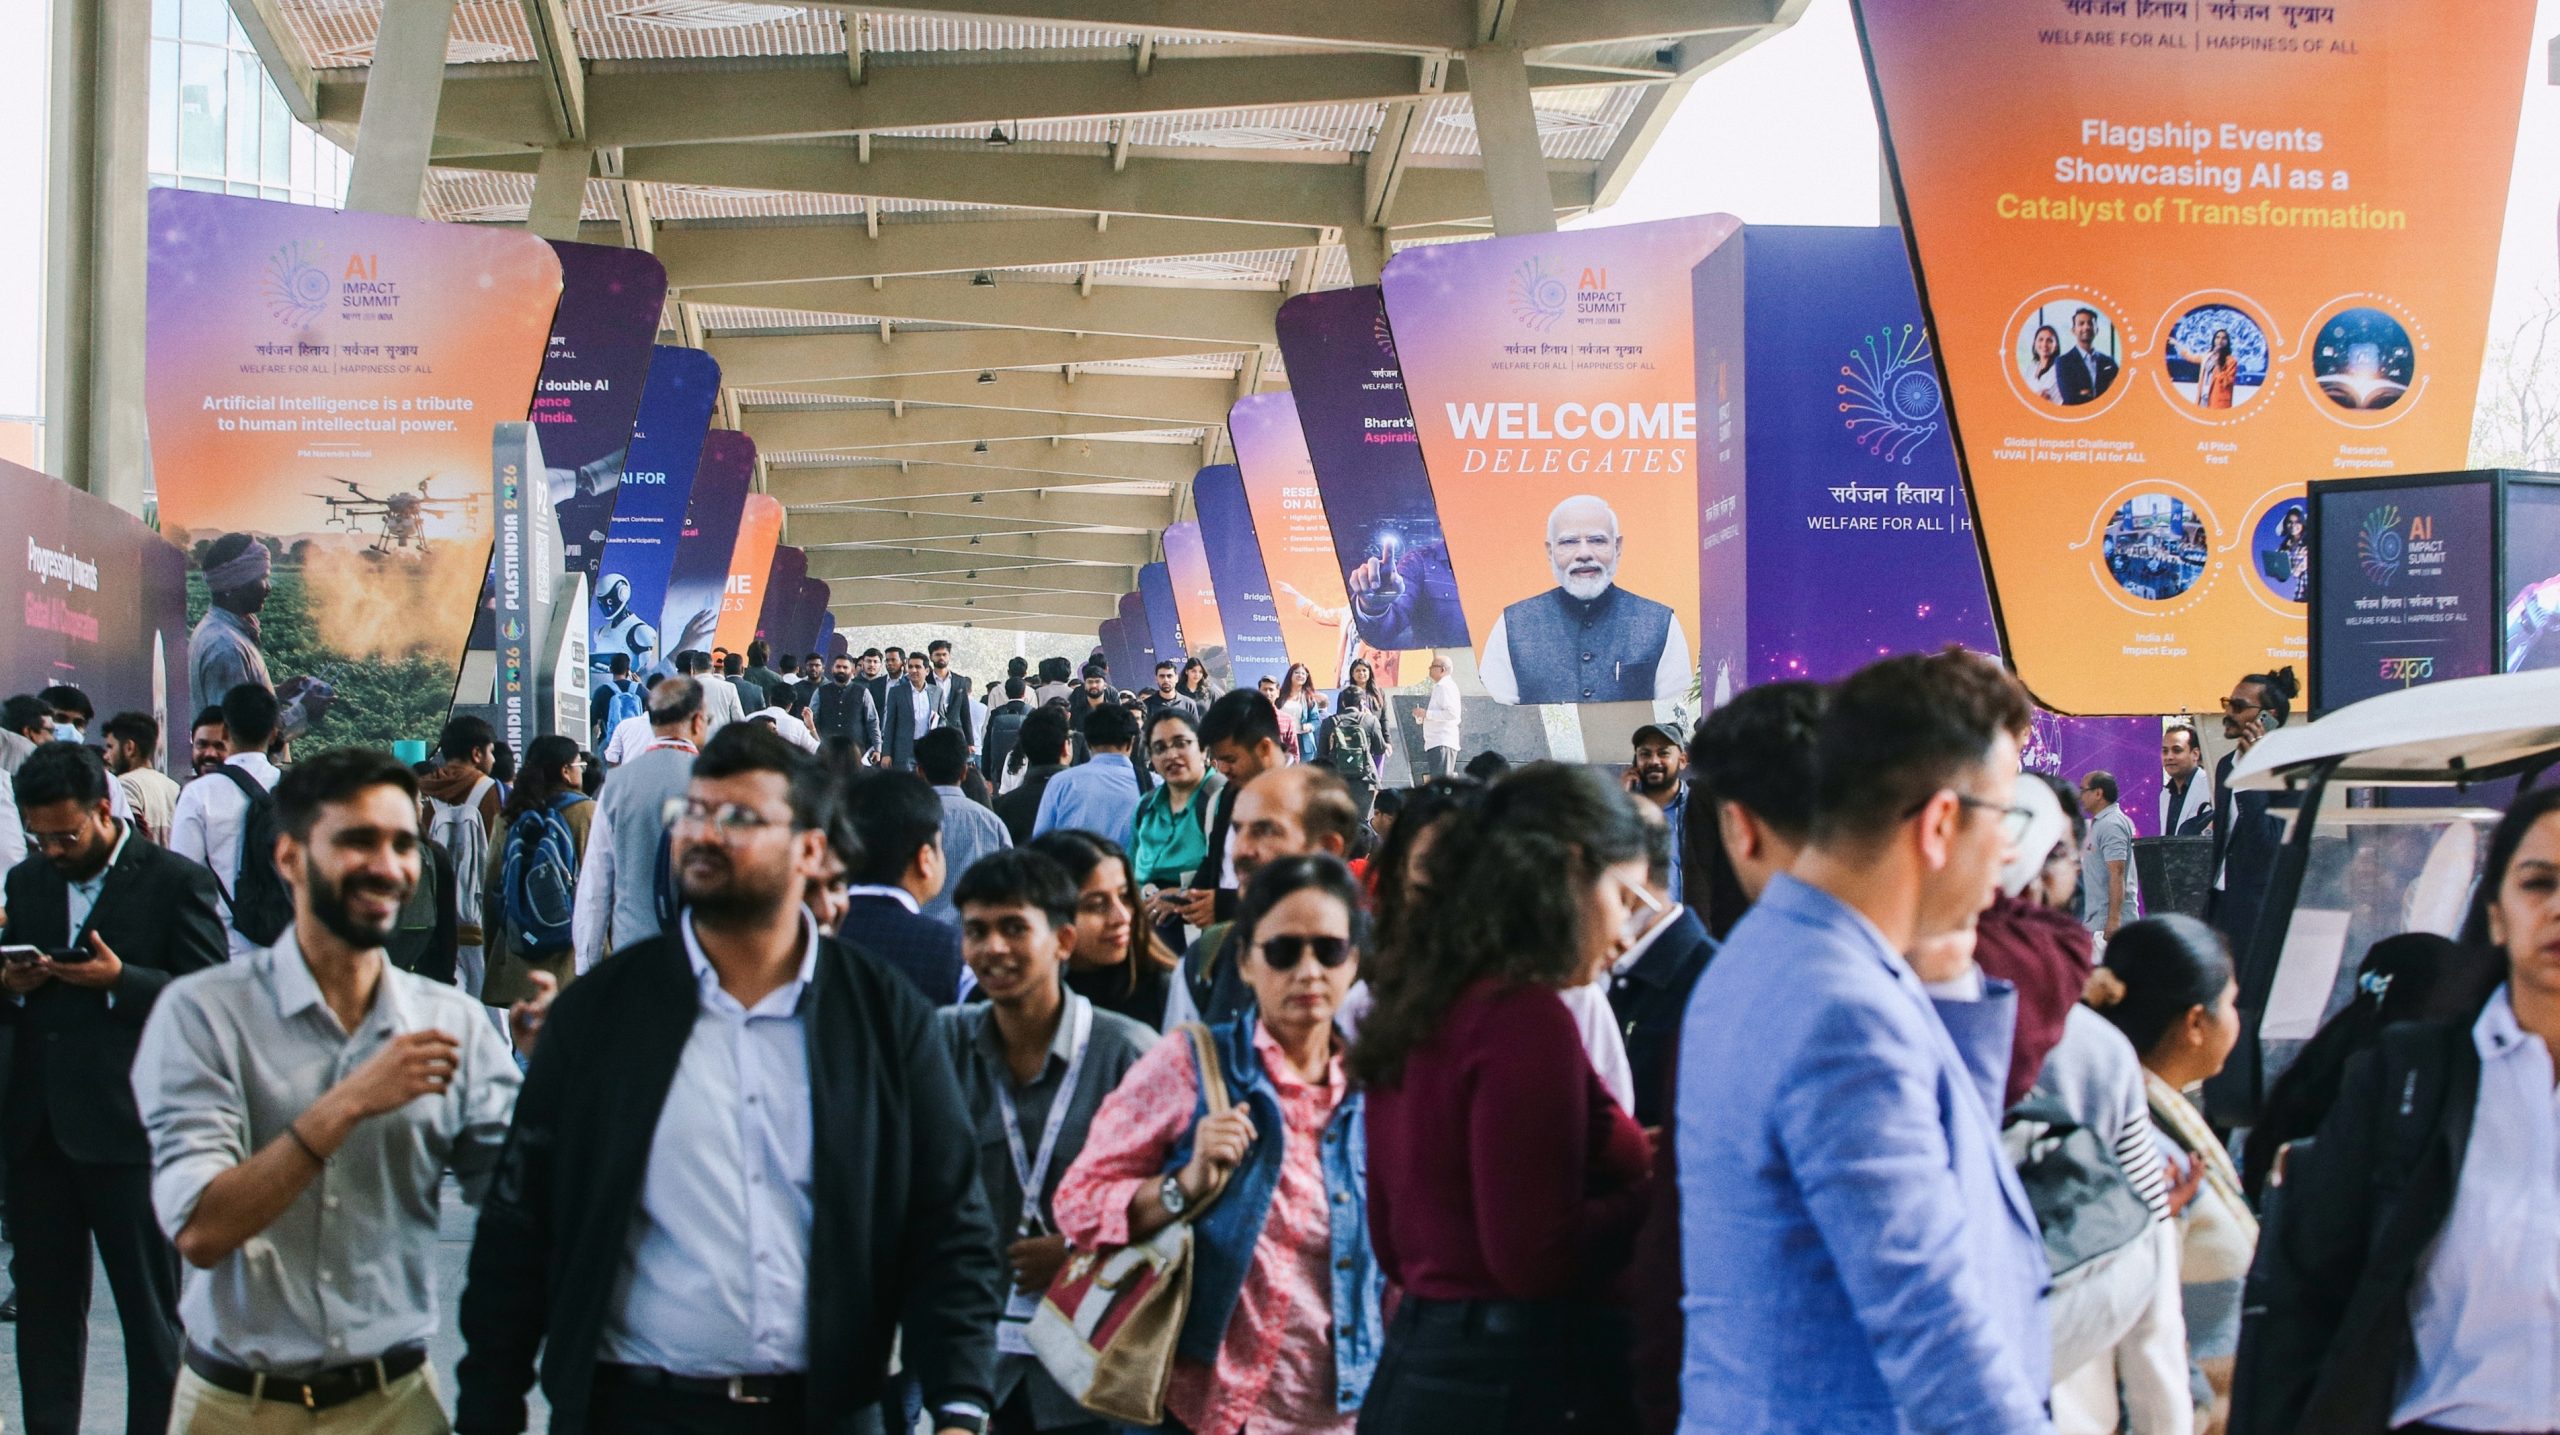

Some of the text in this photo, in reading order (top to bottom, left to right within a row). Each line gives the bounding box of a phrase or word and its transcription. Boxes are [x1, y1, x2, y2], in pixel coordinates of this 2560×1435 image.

[2038, 29, 2357, 55] WELFARE FOR ALL HAPPINESS OF ALL
[2081, 119, 2323, 154] Flagship Events
[2055, 156, 2349, 194] Showcasing AI as a
[1996, 193, 2406, 230] Catalyst of Transformation
[344, 254, 378, 281] AI
[1578, 267, 1607, 290] AI
[343, 283, 396, 294] IMPACT
[342, 296, 400, 307] SUMMIT
[1577, 292, 1623, 302] IMPACT
[1577, 303, 1627, 313] SUMMIT
[240, 364, 432, 374] WELFARE FOR ALL HAPPINESS OF ALL
[1491, 362, 1656, 370] WELFARE FOR ALL HAPPINESS OF ALL
[545, 380, 592, 391] double
[595, 380, 609, 391] AI
[203, 396, 473, 413] Artificial Intelligence is a tribute
[540, 412, 576, 423] India.
[1445, 402, 1696, 440] WELCOME
[217, 417, 458, 434] to human intellectual power.
[2004, 437, 2134, 451] Global Impact Challenges
[2197, 442, 2238, 452] AI Pitch
[2339, 445, 2387, 455] Research
[1462, 448, 1686, 473] DELEGATES
[2037, 451, 2048, 460] AI
[2050, 451, 2063, 462] by
[2065, 451, 2086, 461] HER
[2096, 452, 2107, 461] AI
[2108, 452, 2123, 461] for
[2126, 453, 2145, 462] ALL
[2206, 454, 2228, 465] Fest
[2333, 458, 2394, 469] Symposium
[620, 472, 666, 485] AI FOR
[1283, 488, 1320, 497] RESEA
[1828, 481, 1945, 505] सर्वजन हिताय
[1283, 500, 1316, 509] ON AI
[1807, 516, 1944, 531] WELFARE FOR ALL
[2409, 515, 2433, 540] AI
[2408, 541, 2443, 552] IMPACT
[28, 535, 73, 592] Progressing
[504, 514, 519, 611] PLASTINDIA
[2408, 552, 2447, 565] SUMMIT
[1243, 592, 1273, 603] Bridgin
[1252, 614, 1279, 623] Startu
[1237, 634, 1273, 642] Research
[2135, 633, 2174, 642] India AI
[2122, 645, 2188, 657] Impact Expo
[2266, 647, 2307, 659] Tinkerp
[1235, 655, 1279, 663] Businesses
[507, 697, 522, 773] STINDIA
